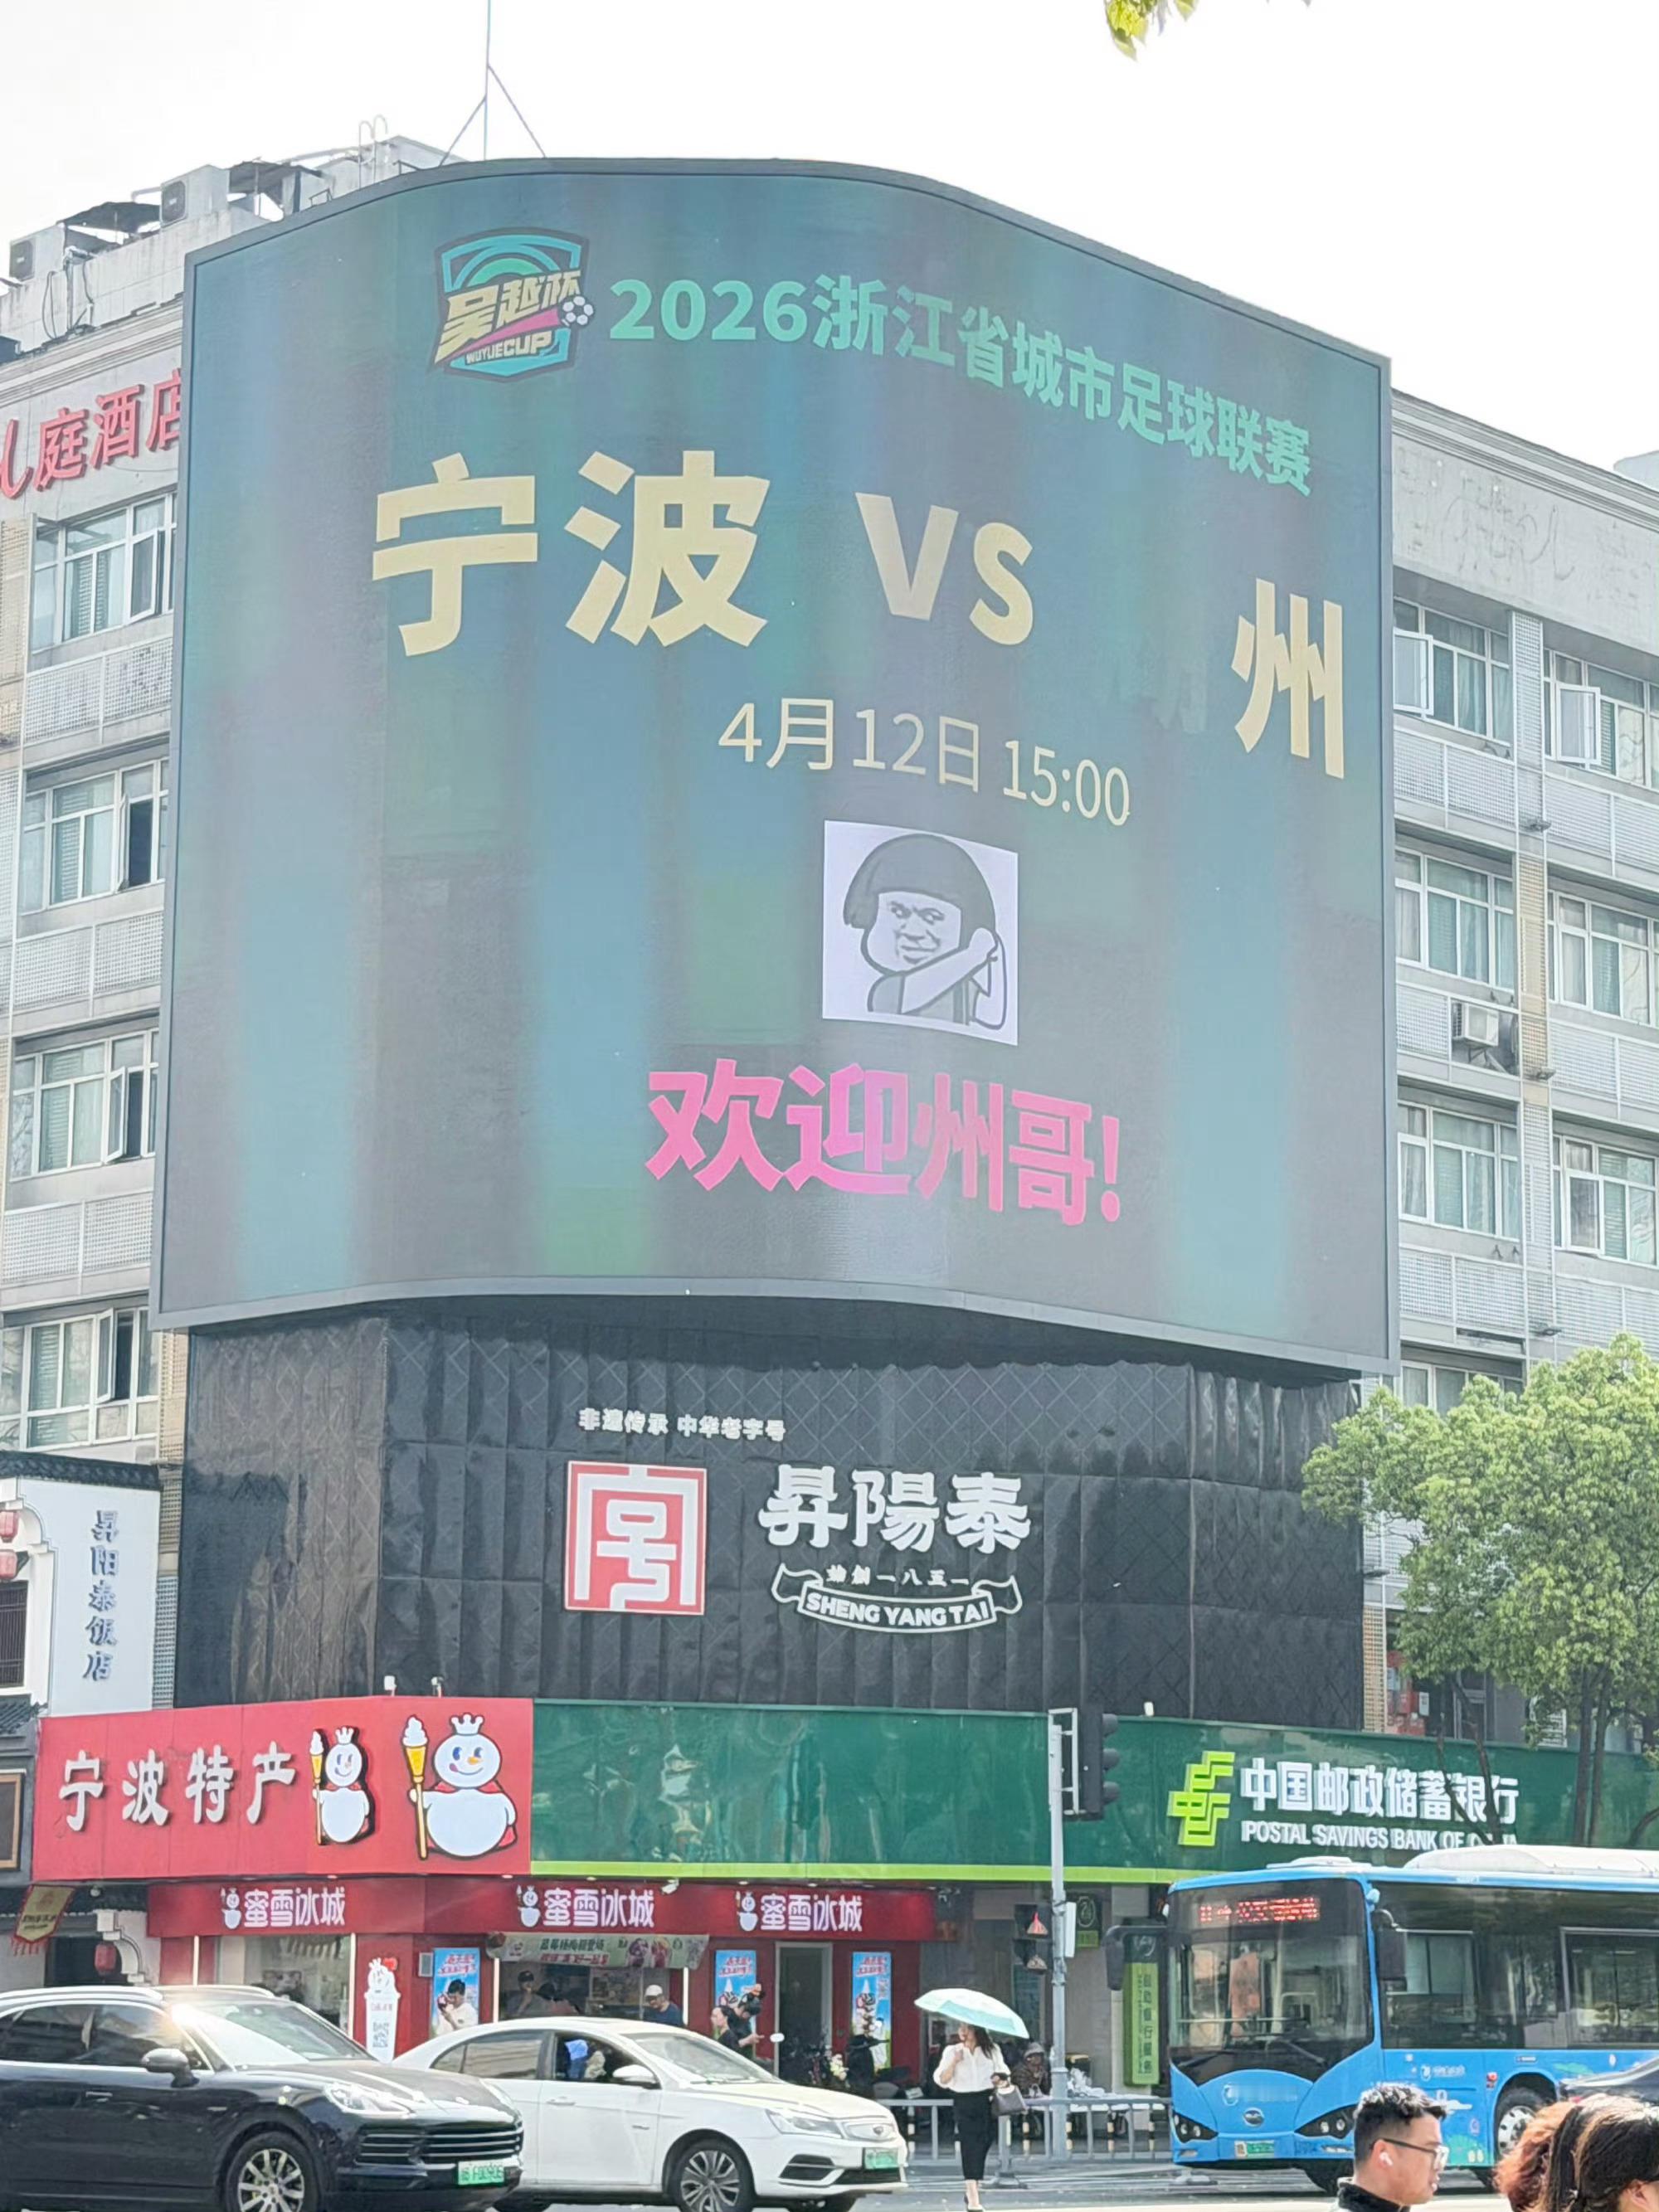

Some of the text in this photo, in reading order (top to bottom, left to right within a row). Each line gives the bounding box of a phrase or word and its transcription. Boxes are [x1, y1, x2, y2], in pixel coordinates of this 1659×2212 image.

[435, 270, 581, 363] 吴越杯
[611, 275, 1311, 494] 2026浙江省城市足球联赛
[372, 450, 1345, 779] 宁波 VS 州
[718, 698, 1131, 827] 4月12日 15:00
[645, 1057, 1121, 1226] 欢迎州哥!
[578, 1407, 786, 1441] 非遗传承 中华老字号
[758, 1464, 1031, 1554] 昇陽泰
[805, 1592, 990, 1626] SHENG YANG TAI
[58, 1740, 296, 1833] 宁波特产
[1240, 1757, 1520, 1825] 中国邮政储蓄银行
[1241, 1821, 1311, 1845] POSTAL
[1311, 1825, 1389, 1850] SAVINGS
[1390, 1828, 1438, 1850] BANK
[244, 1886, 346, 1928] 蜜雪冰城
[543, 1888, 655, 1928] 蜜雪冰城
[761, 1894, 864, 1932] 蜜雪冰城
